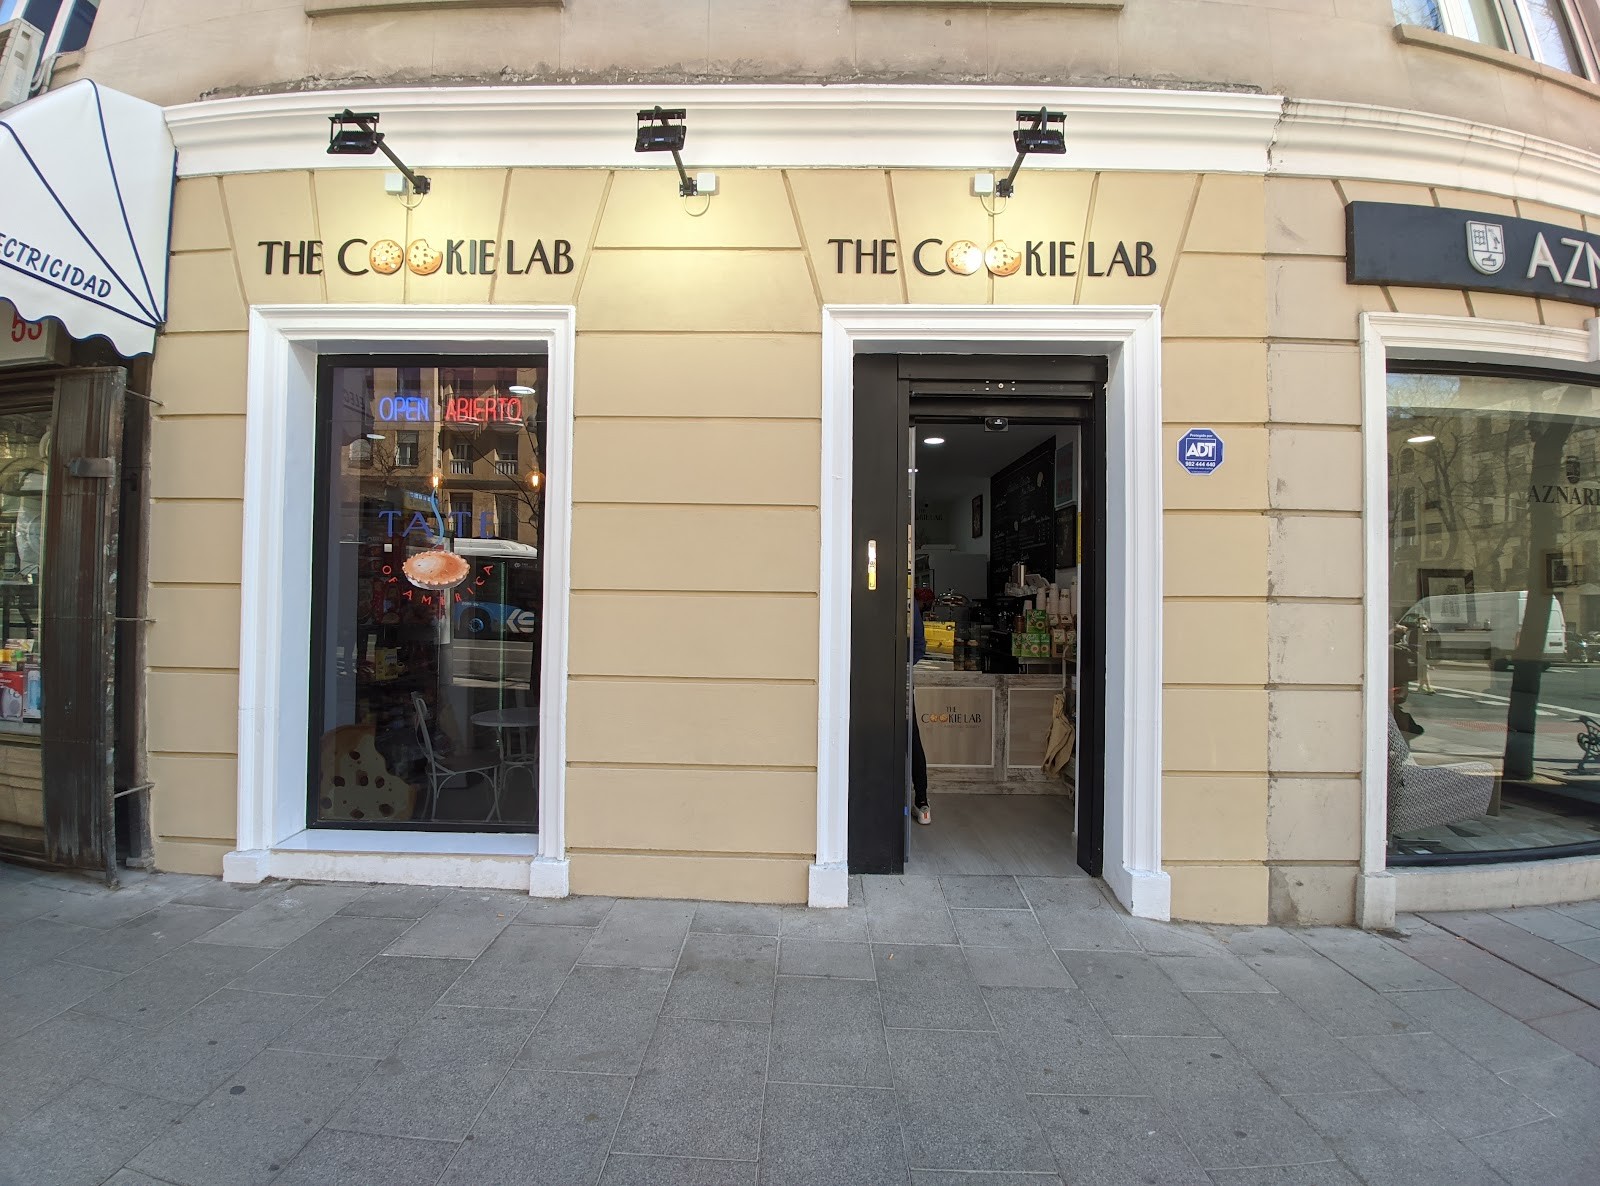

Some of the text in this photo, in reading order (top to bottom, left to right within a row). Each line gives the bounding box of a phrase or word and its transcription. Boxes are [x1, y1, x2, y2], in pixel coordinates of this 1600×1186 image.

[257, 238, 575, 276] THE COOKIE LAB
[827, 238, 1157, 277] THE COOKIE LAB
[378, 396, 523, 423] OPEN ABIERTO
[1186, 442, 1216, 457] ADT
[378, 496, 496, 546] TASTE
[920, 712, 982, 724] COOKIE LAB
